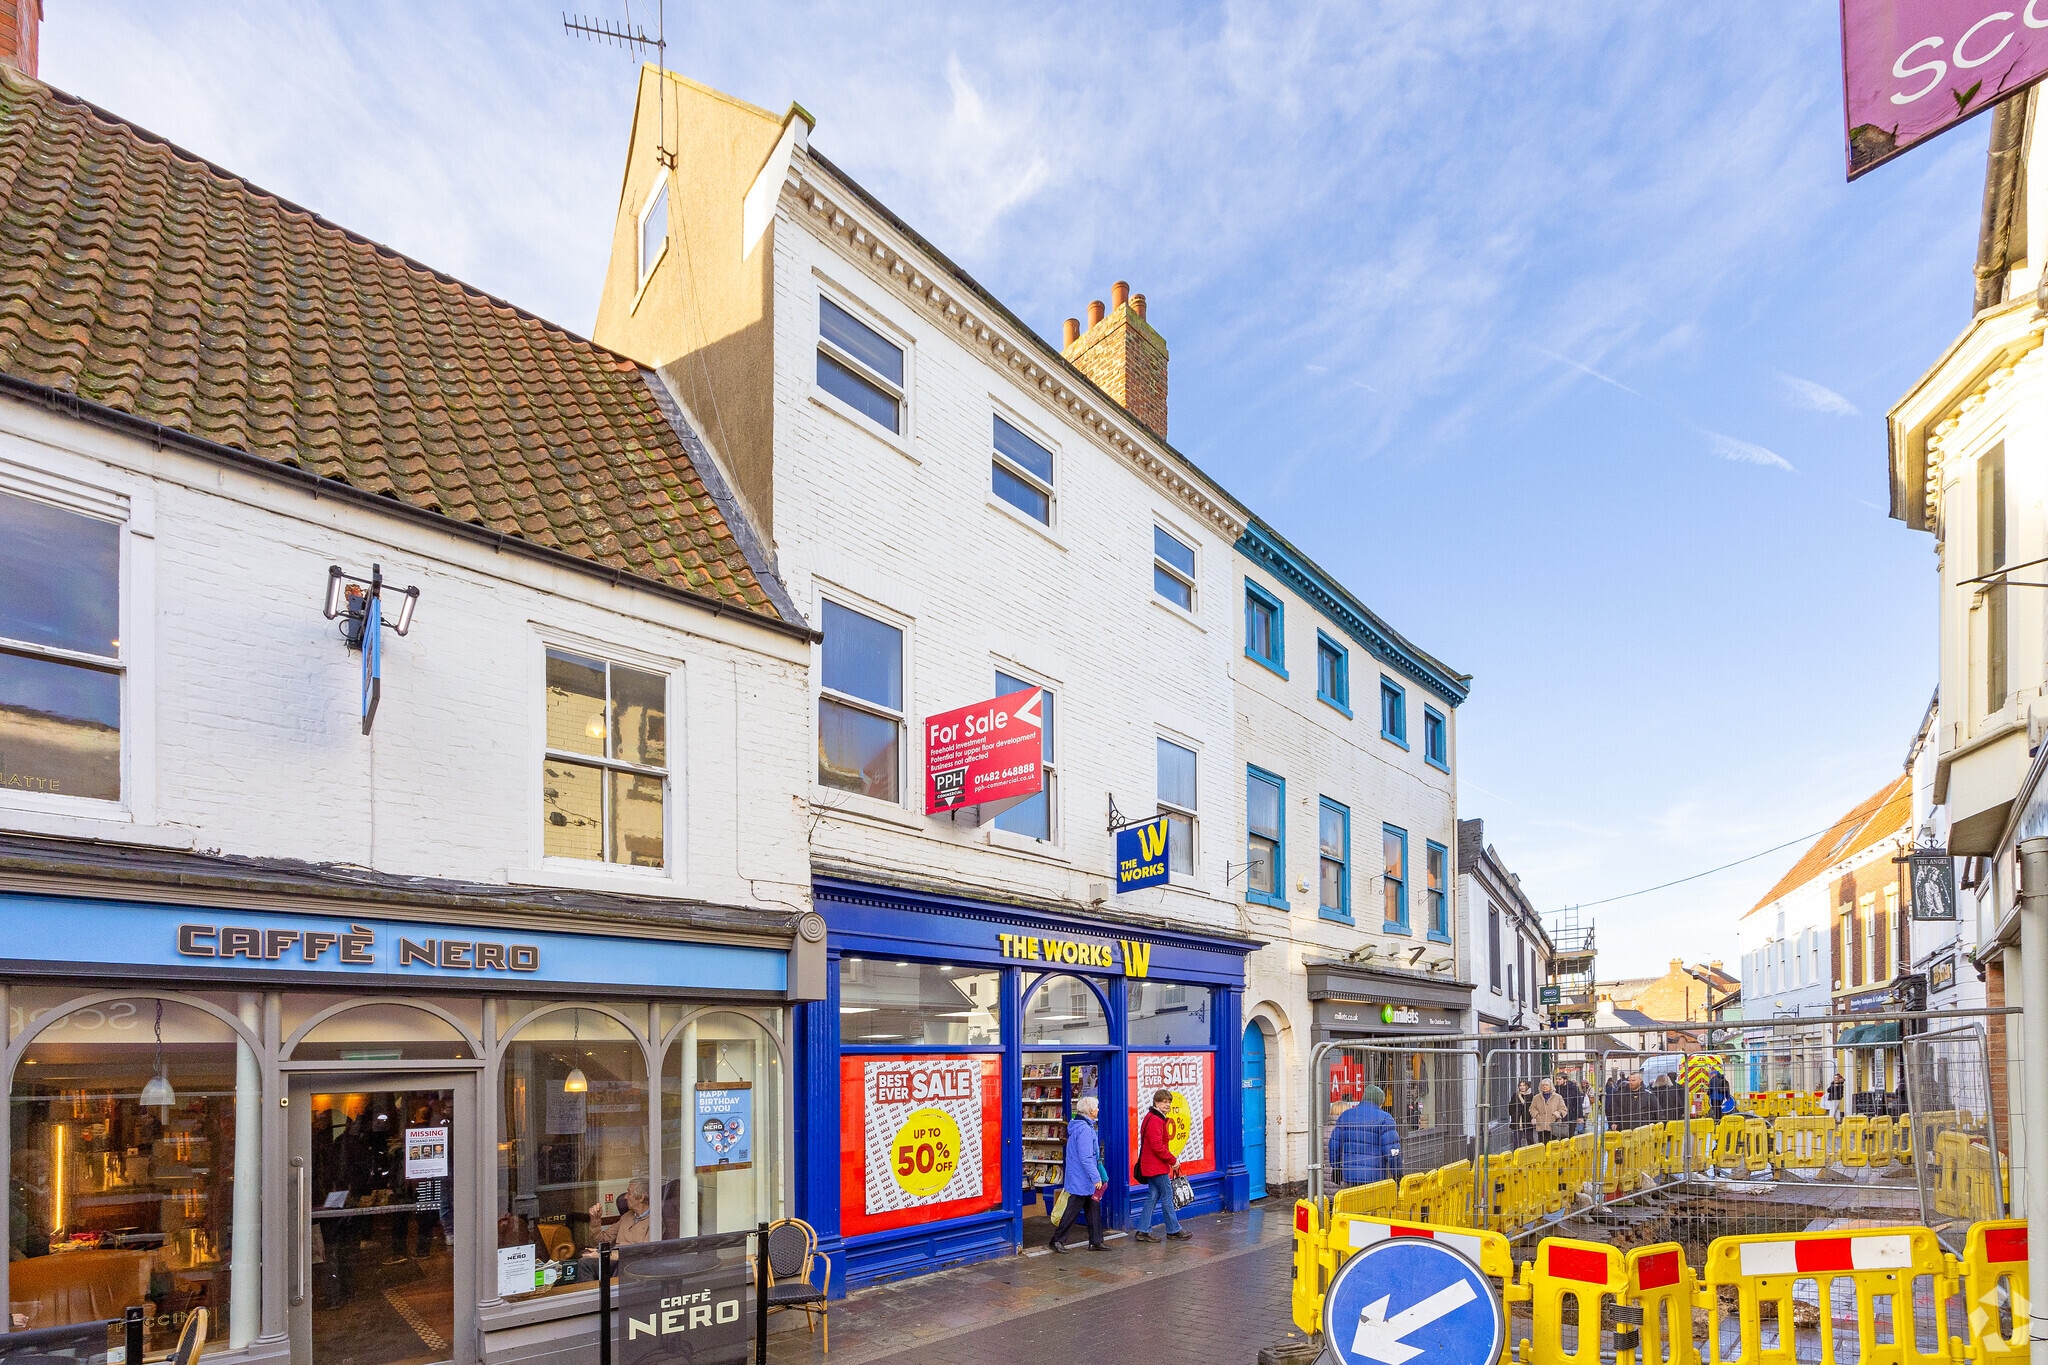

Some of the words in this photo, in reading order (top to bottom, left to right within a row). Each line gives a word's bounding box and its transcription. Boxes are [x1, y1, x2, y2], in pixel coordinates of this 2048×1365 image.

[930, 723, 959, 747] For
[965, 709, 1008, 738] Sale
[931, 752, 955, 764] Potential
[955, 750, 963, 758] for
[964, 746, 981, 758] upper
[981, 743, 995, 751] floor
[996, 732, 1036, 748] development
[931, 744, 955, 756] Freehold
[931, 761, 954, 772] Business
[954, 758, 964, 767] not
[964, 752, 989, 764] affected
[937, 771, 963, 790] PPH
[974, 771, 1000, 785] 01482
[1002, 763, 1035, 778] 648888
[974, 774, 1035, 793] pph-commercial.co.uk
[937, 790, 963, 799] COMMERCIAL
[1120, 858, 1137, 871] THE
[1120, 862, 1165, 883] WORKS
[177, 923, 375, 964] CAFFÈ
[399, 936, 541, 972] NERO
[999, 933, 1039, 960] THE
[1042, 938, 1113, 967] WORKS
[1394, 1006, 1419, 1024] millets
[1145, 1066, 1161, 1075] BEST
[1163, 1065, 1197, 1085] SALE
[879, 1074, 909, 1087] BEST
[912, 1071, 970, 1099] SALE
[1145, 1076, 1162, 1085] EVER
[699, 1090, 728, 1098] HAPPY
[879, 1088, 909, 1100] EVER
[699, 1097, 740, 1106] BIRTHDAY
[699, 1105, 711, 1113] TO
[712, 1104, 731, 1112] YOU
[1172, 1106, 1180, 1114] TO
[410, 1130, 444, 1138] MISSING
[914, 1129, 926, 1139] UP
[928, 1128, 941, 1138] TO
[1166, 1117, 1185, 1140] 0%
[1177, 1132, 1186, 1140] OFF
[898, 1142, 950, 1176] 50%
[936, 1161, 953, 1173] OFF
[540, 1214, 566, 1223] NERO
[507, 1253, 527, 1261] NERO
[660, 1288, 711, 1309] CAFFÈ
[628, 1299, 740, 1341] NERO
